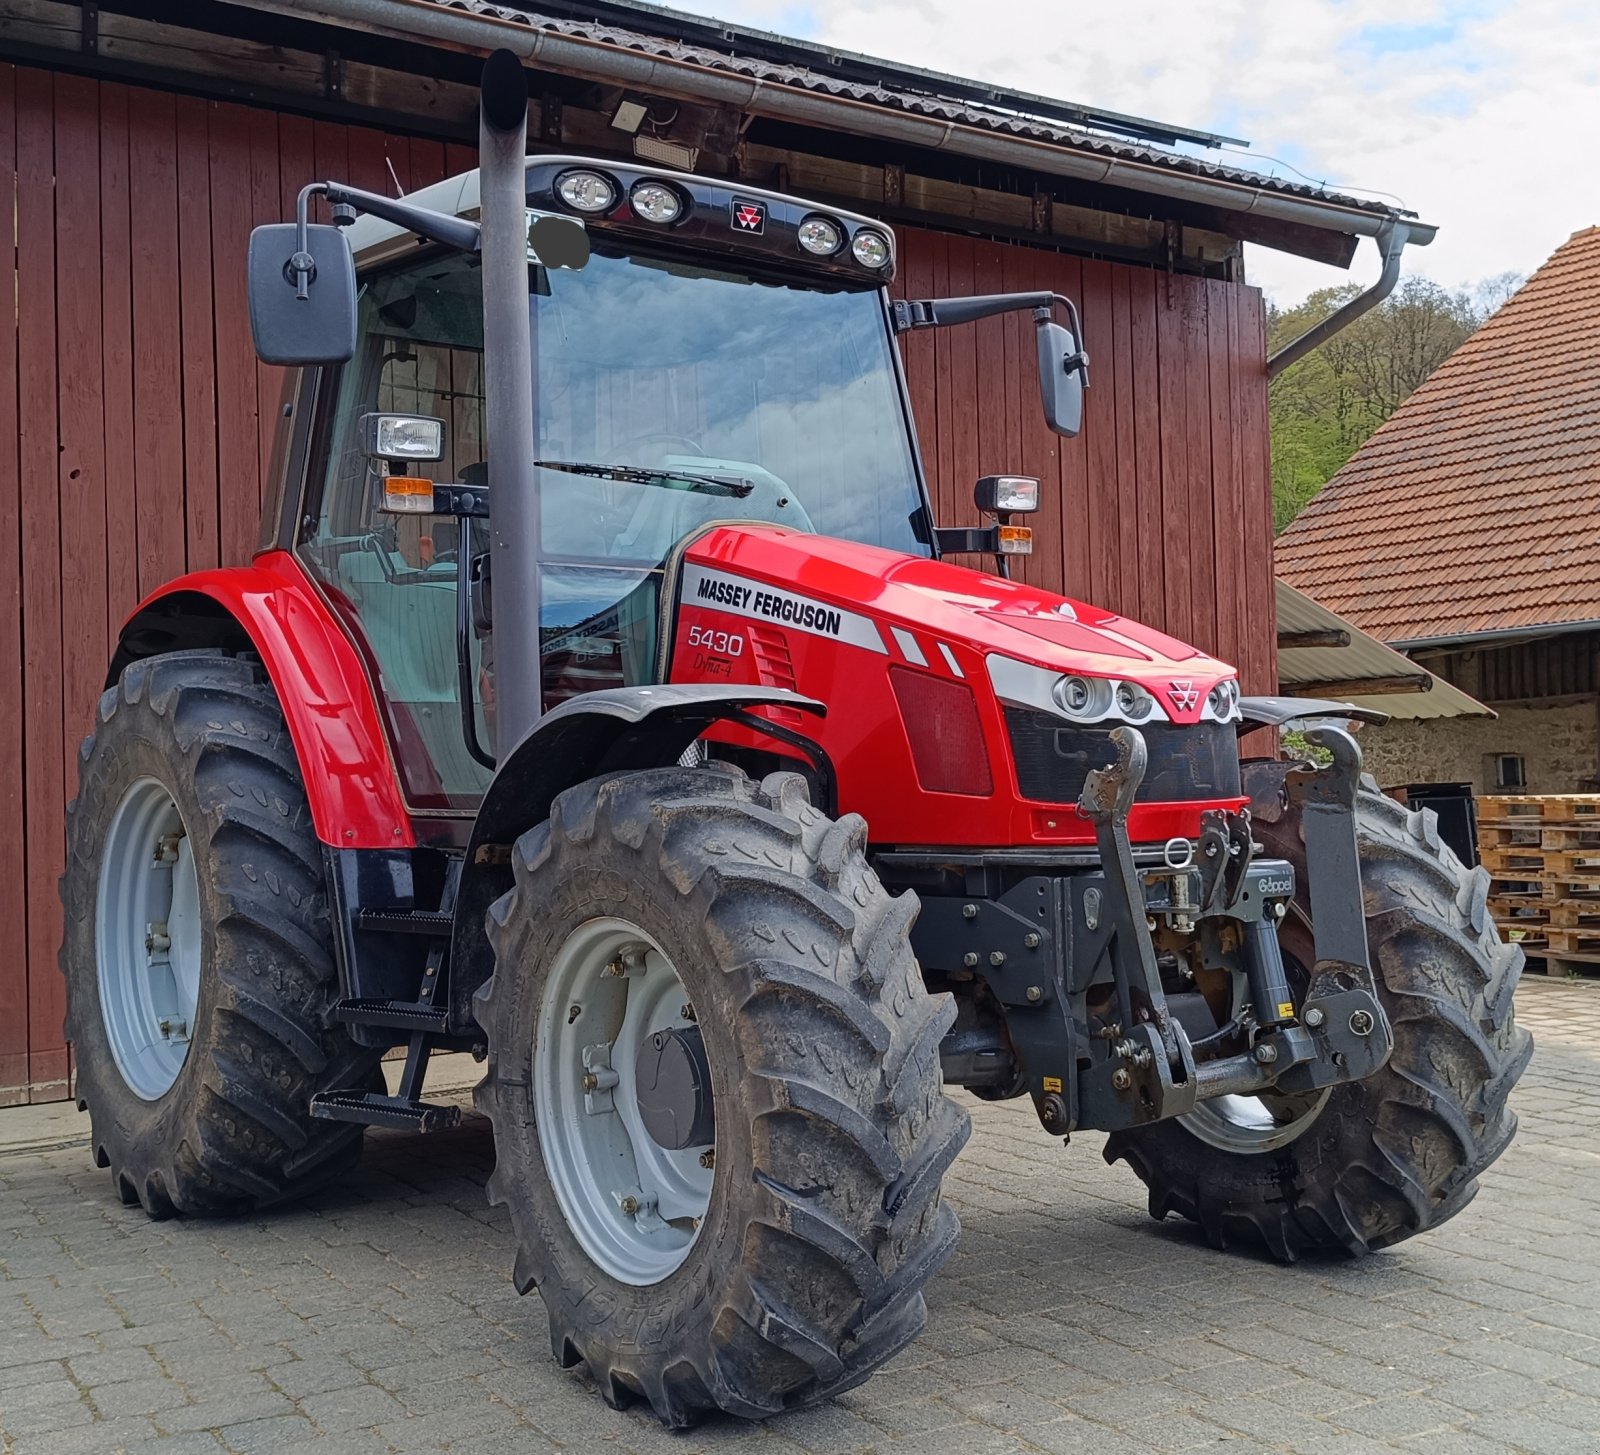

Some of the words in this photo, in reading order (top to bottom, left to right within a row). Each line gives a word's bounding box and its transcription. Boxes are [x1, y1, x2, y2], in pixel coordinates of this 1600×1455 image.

[697, 578, 752, 609] MASSEY
[753, 591, 841, 635] FERGUSON
[688, 625, 743, 656] 5430
[693, 653, 732, 677] Dyna-4
